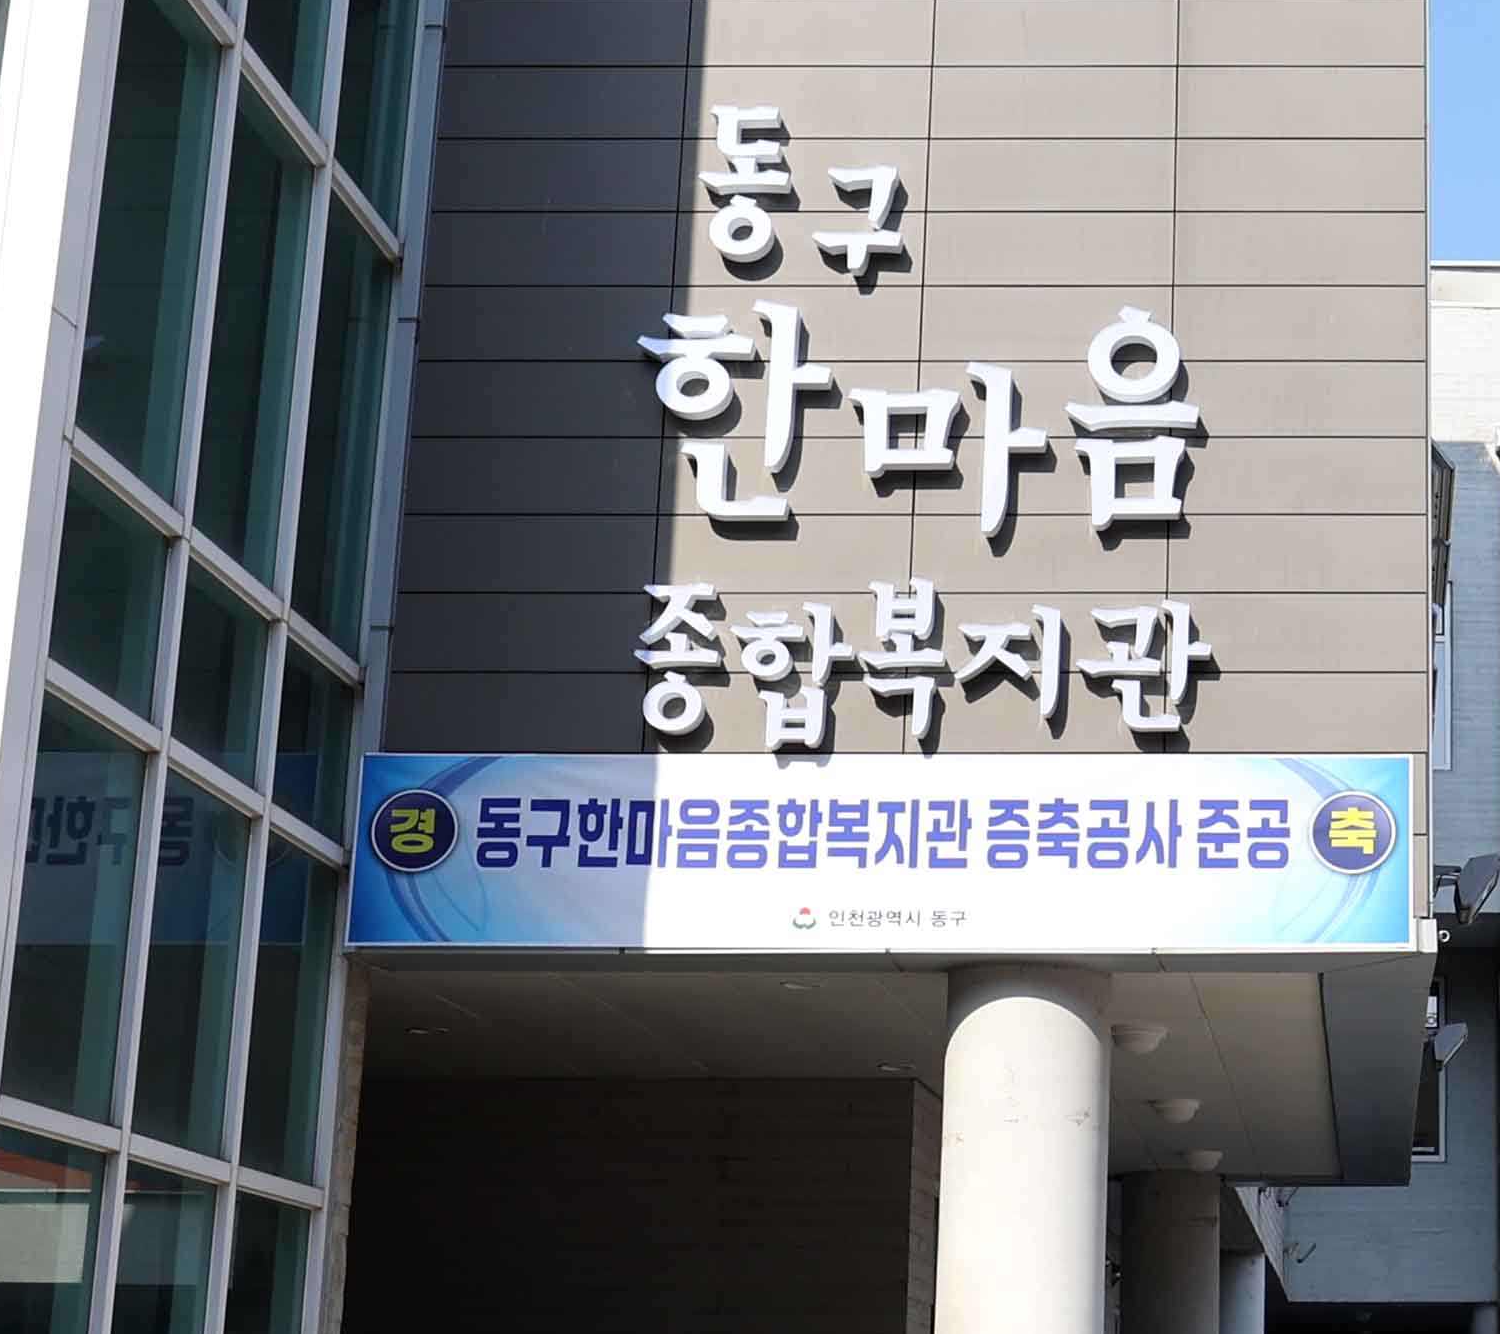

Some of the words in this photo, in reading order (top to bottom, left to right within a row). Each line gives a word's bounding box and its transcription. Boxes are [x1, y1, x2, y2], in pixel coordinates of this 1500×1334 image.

[700, 104, 905, 278] 동구
[637, 300, 1200, 539] 한마음
[634, 577, 1212, 751] 종합복지관
[389, 808, 436, 855] 경
[475, 797, 973, 869] 동구한마음종합복지관
[987, 797, 1182, 869] 증축공사
[1197, 798, 1291, 869] 준공
[1328, 806, 1377, 856] 축
[828, 910, 922, 928] 인천광역시
[931, 910, 968, 928] 동구
